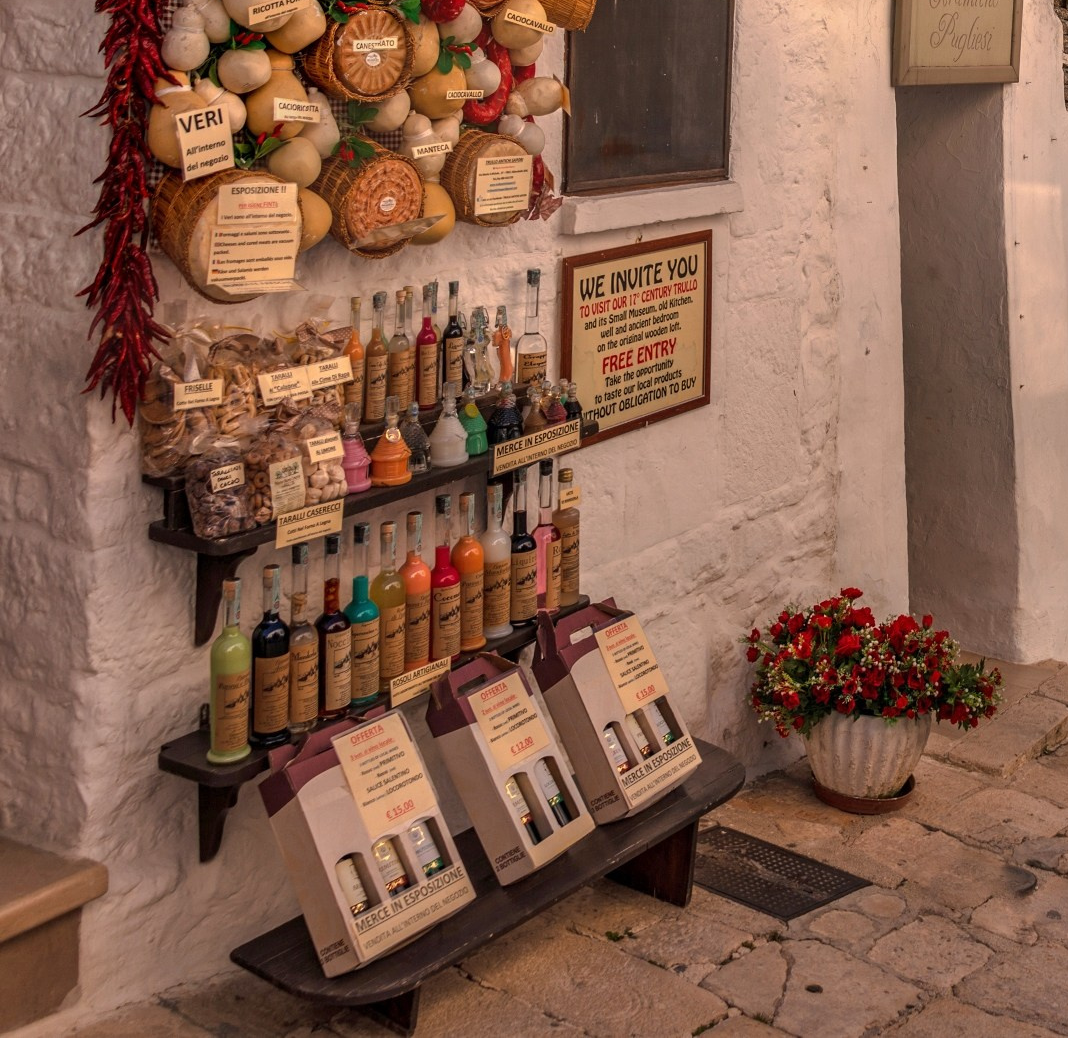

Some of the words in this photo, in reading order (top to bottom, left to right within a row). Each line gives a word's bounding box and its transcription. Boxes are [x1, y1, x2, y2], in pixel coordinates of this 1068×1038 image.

[252, 0, 284, 15] RICOTTA
[507, 12, 554, 32] CACIOCAVALLO
[930, 12, 996, 62] Pugliesi
[278, 102, 319, 112] CACIORICOTTA
[179, 108, 223, 134] VERI
[186, 140, 226, 156] All'interno
[416, 144, 450, 155] MANTECA
[186, 163, 198, 172] del
[200, 155, 228, 168] negozio
[232, 186, 280, 194] ESPOSIZIONE
[580, 274, 606, 302] WE
[611, 262, 662, 294] INVITE
[668, 254, 698, 280] YOU
[580, 306, 590, 318] TO
[592, 300, 610, 316] VISIT
[612, 296, 627, 310] OUR
[642, 285, 672, 303] CENTURY
[674, 278, 698, 295] TRULLO
[584, 318, 596, 330] and
[598, 316, 608, 327] its
[608, 310, 627, 324] Small
[659, 300, 668, 311] old
[600, 326, 614, 338] well
[615, 322, 626, 335] and
[628, 318, 651, 331] ancient
[652, 312, 679, 325] bedroom
[597, 344, 606, 352] on
[608, 338, 618, 350] the
[620, 331, 644, 347] original
[645, 326, 668, 339] wooden
[602, 349, 634, 374] FREE
[637, 338, 676, 364] ENTRY
[271, 372, 292, 380] TARALLI
[319, 362, 338, 371] TARALLI
[605, 376, 622, 388] Take
[624, 371, 634, 382] the
[636, 359, 674, 378] opportunity
[185, 382, 213, 392] FRISELLE
[595, 394, 602, 404] to
[604, 389, 622, 402] taste
[624, 384, 636, 395] our
[637, 378, 652, 392] local
[654, 369, 682, 386] products
[584, 402, 617, 420] ITHOUT
[618, 386, 667, 412] OBLIGATION
[669, 382, 680, 394] TO
[682, 376, 696, 391] BUY
[496, 440, 524, 457] MERCE
[525, 438, 532, 448] IN
[534, 422, 578, 444] ESPOSIZIONE
[496, 460, 518, 472] VENDITA
[518, 450, 548, 464] ALL'INTERNO
[558, 438, 578, 450] NEGOZIO
[279, 512, 305, 525] TARALLI
[306, 503, 340, 518] CASERECCI
[605, 622, 628, 637] OFFERTA
[392, 674, 412, 688] ROSOLI
[413, 659, 449, 678] ARTIGIANALI
[480, 682, 508, 700] OFFERTA
[640, 684, 656, 698] 15,00
[508, 708, 528, 722] PRIMITIVO
[350, 725, 384, 744] OFFERTA
[516, 736, 534, 751] 12,00
[380, 751, 405, 766] PRIMITIVO
[622, 767, 645, 787] MERCE
[644, 763, 652, 774] IN
[653, 738, 692, 768] ESPOSIZIONE
[366, 782, 382, 794] SALICE
[383, 768, 410, 786] SALENTINO
[386, 773, 424, 794] LOCOROTONDO
[630, 787, 648, 800] VENDITA
[648, 770, 672, 790] ALL'INTERNO
[680, 754, 696, 770] NEGOZIO
[591, 790, 616, 806] CONTIENE
[596, 795, 620, 812] BOTTIGLIE
[386, 810, 392, 819] €
[392, 800, 414, 816] 15,00
[495, 846, 521, 864] CONTIENE
[500, 850, 527, 870] BOTTIGLIE
[354, 907, 390, 932] MERCE
[391, 902, 404, 914] IN
[404, 866, 465, 907] ESPOSIZIONE
[366, 930, 390, 950] VENDITA
[392, 909, 430, 934] ALL'INTERNO
[430, 903, 442, 915] DEL
[442, 886, 469, 907] NEGOZIO
[320, 938, 345, 957] CONTIENE
[324, 944, 350, 964] BOTTIGLIE
